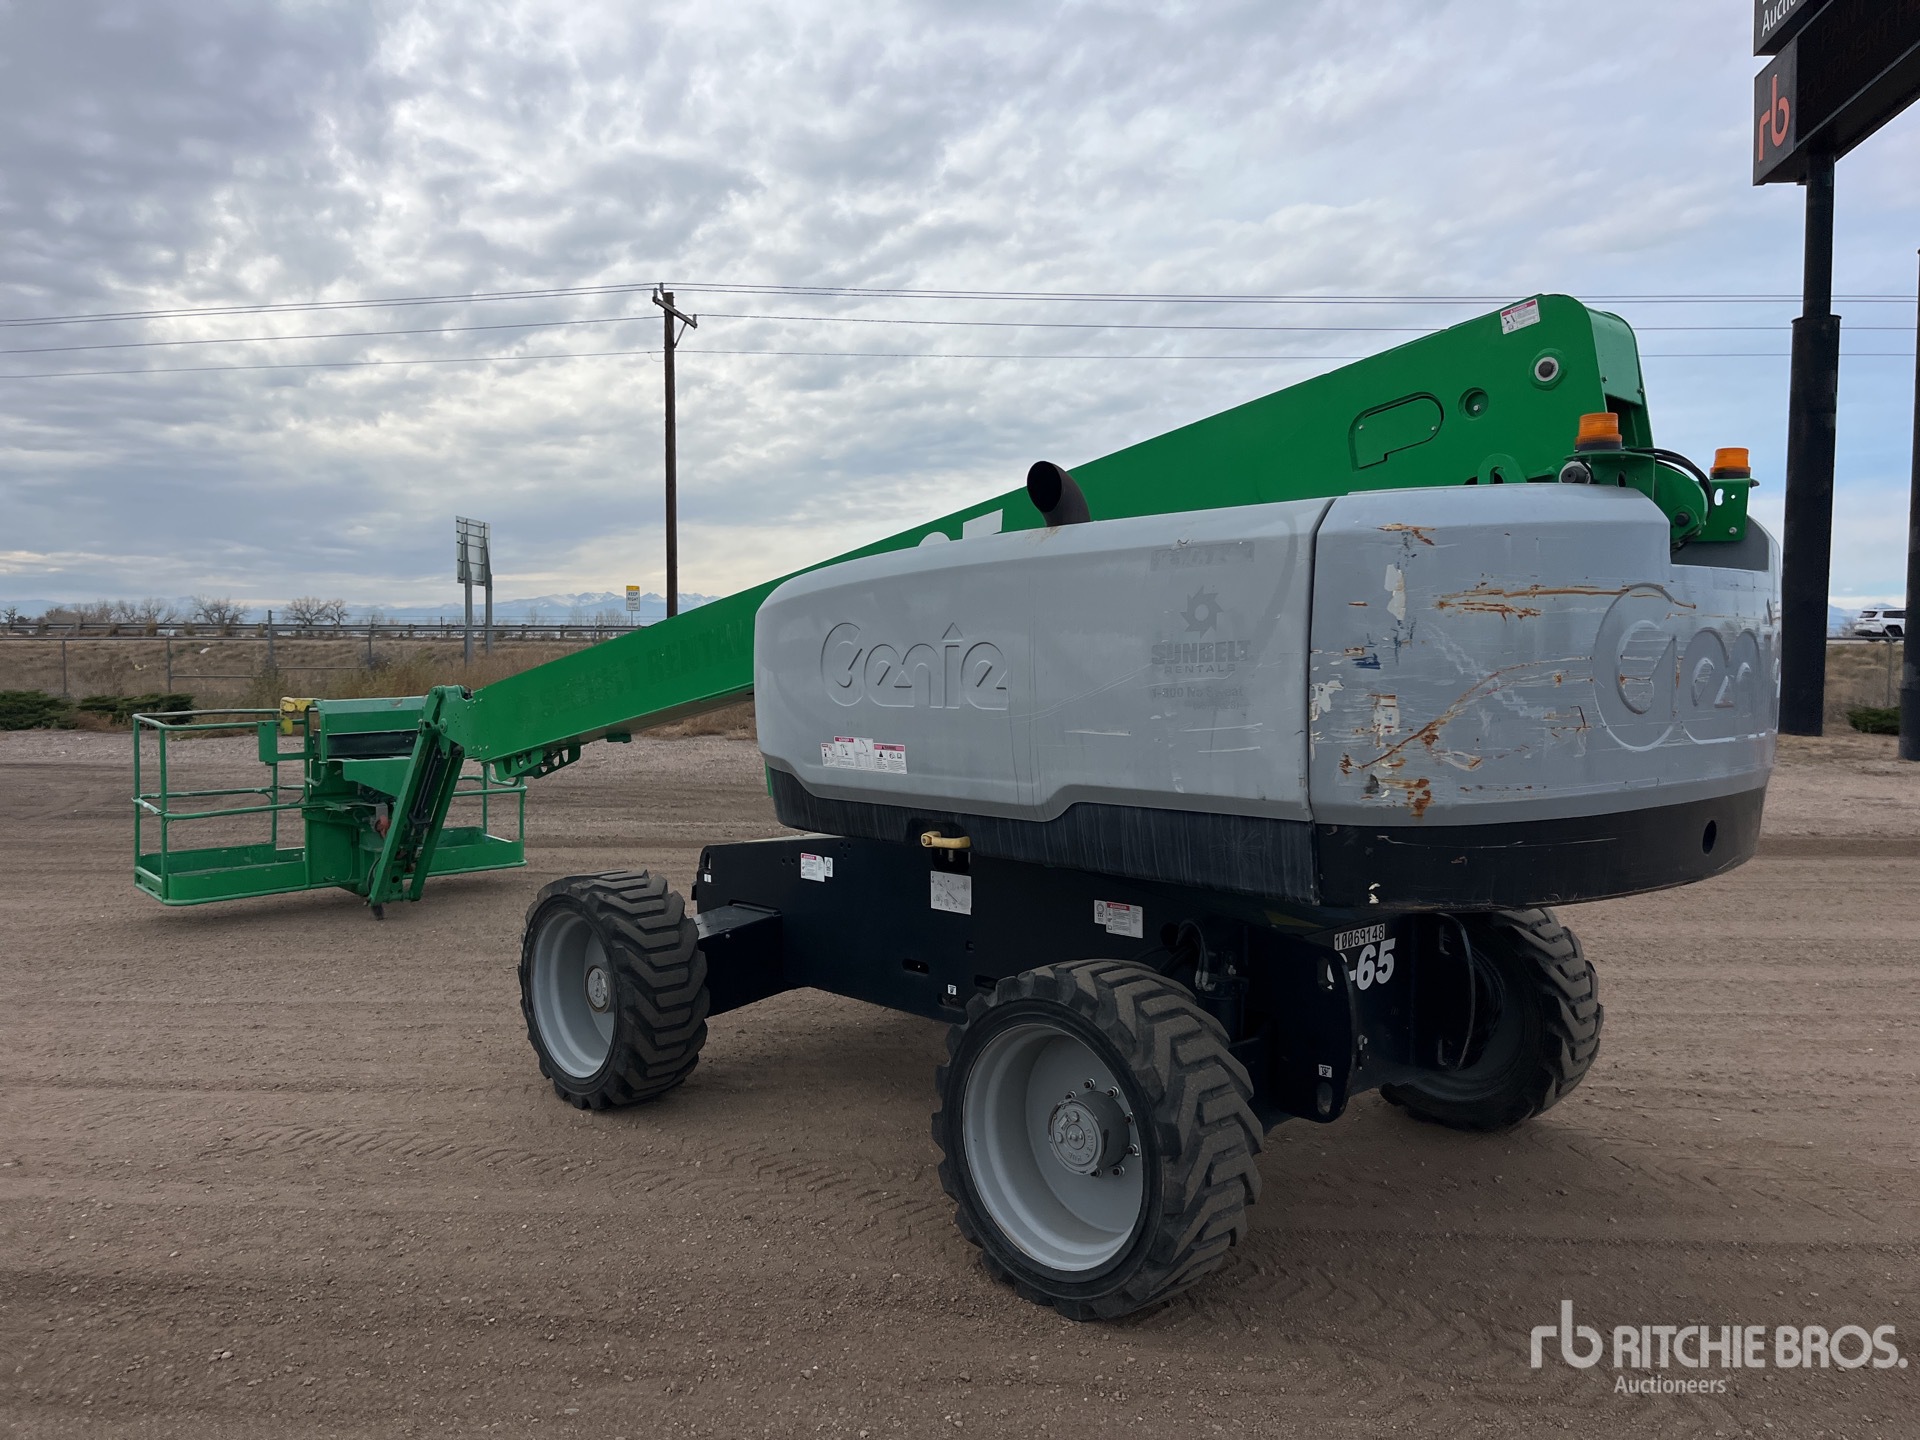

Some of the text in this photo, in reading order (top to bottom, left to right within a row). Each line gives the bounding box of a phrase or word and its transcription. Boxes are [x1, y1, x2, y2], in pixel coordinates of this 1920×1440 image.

[1758, 74, 1790, 163] rb
[1151, 639, 1252, 665] SUNBELT
[820, 621, 1009, 711] Genie
[1164, 663, 1236, 675] RENTALS
[1187, 686, 1203, 698] No
[1335, 924, 1384, 950] 10069148
